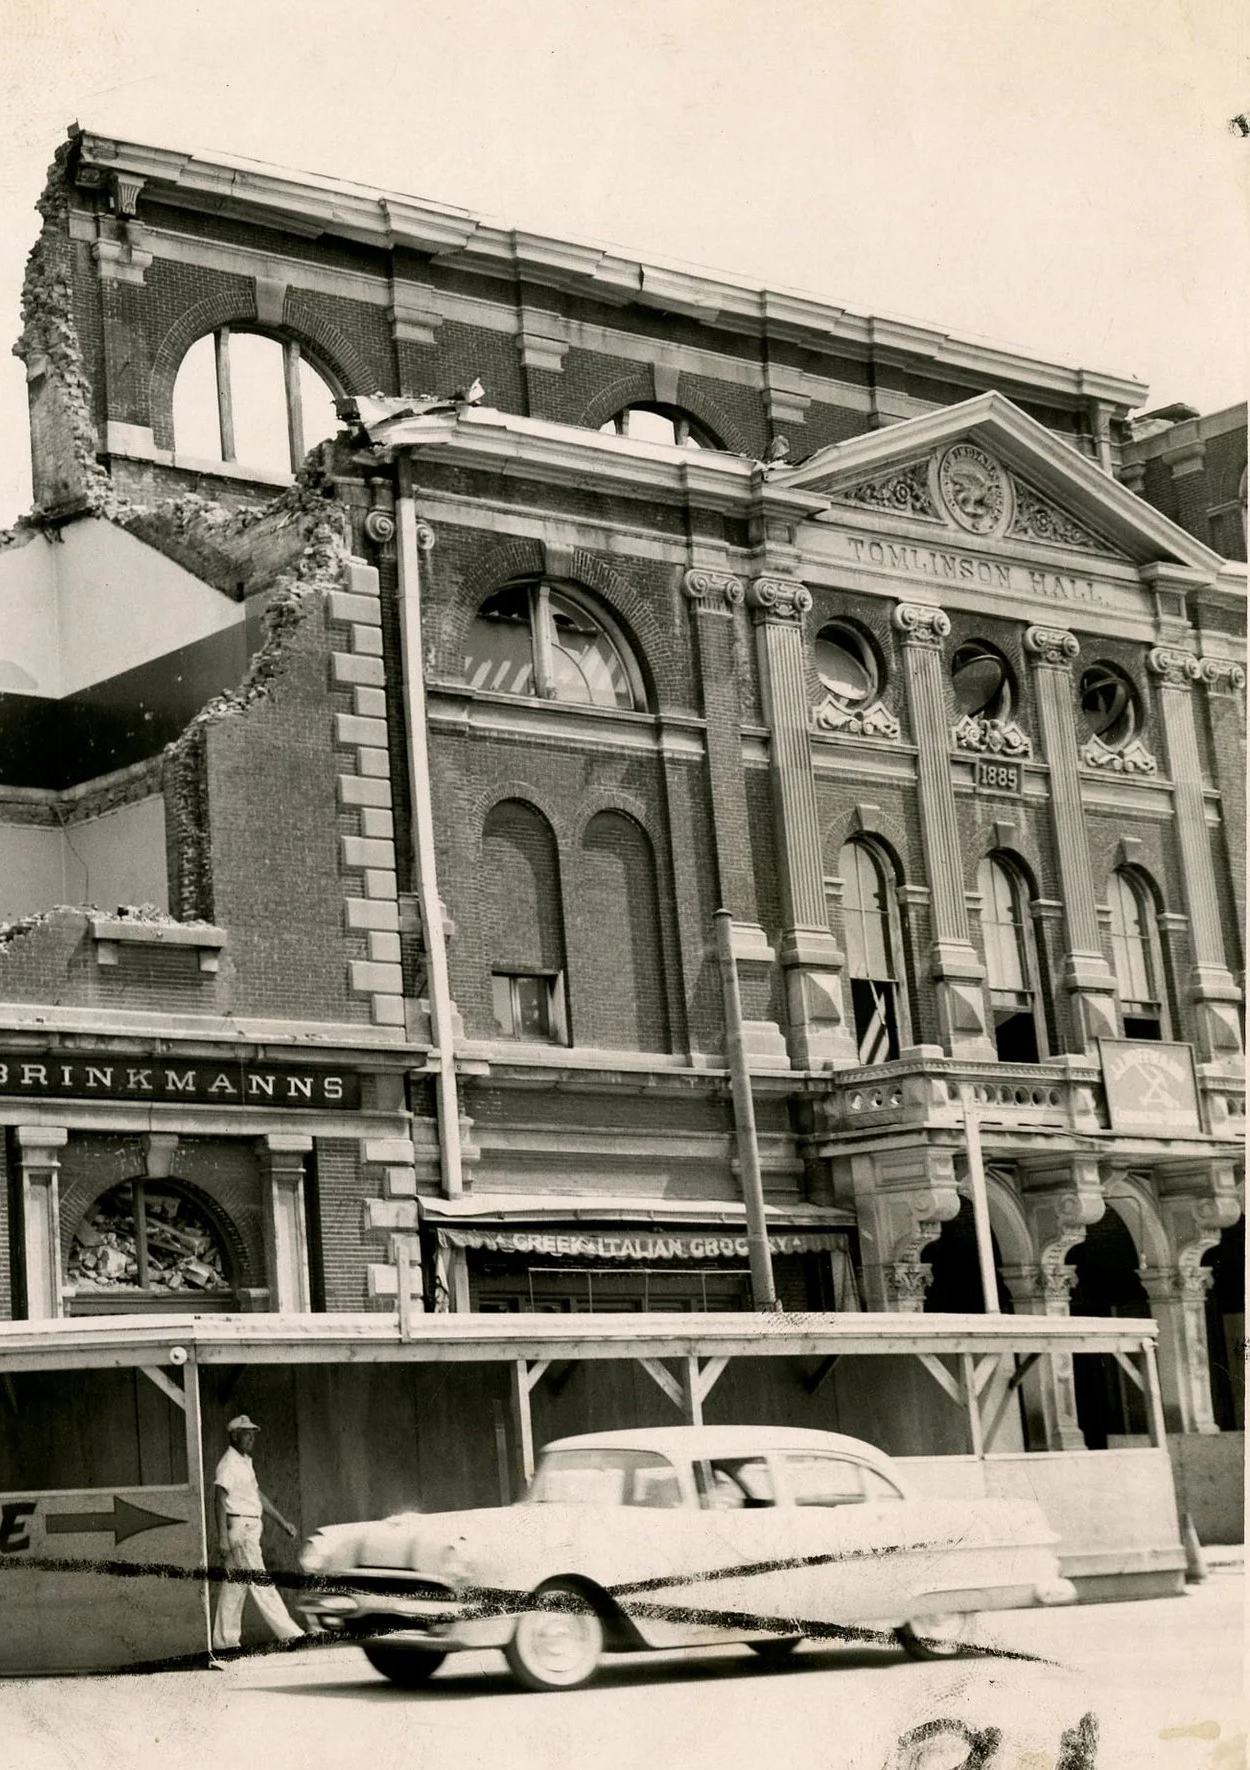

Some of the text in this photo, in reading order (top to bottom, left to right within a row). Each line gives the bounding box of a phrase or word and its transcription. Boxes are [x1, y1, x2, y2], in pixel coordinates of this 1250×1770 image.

[848, 537, 1011, 590] TOMLINSON
[980, 764, 1018, 791] 1885
[512, 1233, 584, 1256] GREEK
[598, 1237, 687, 1259] ITALIAN
